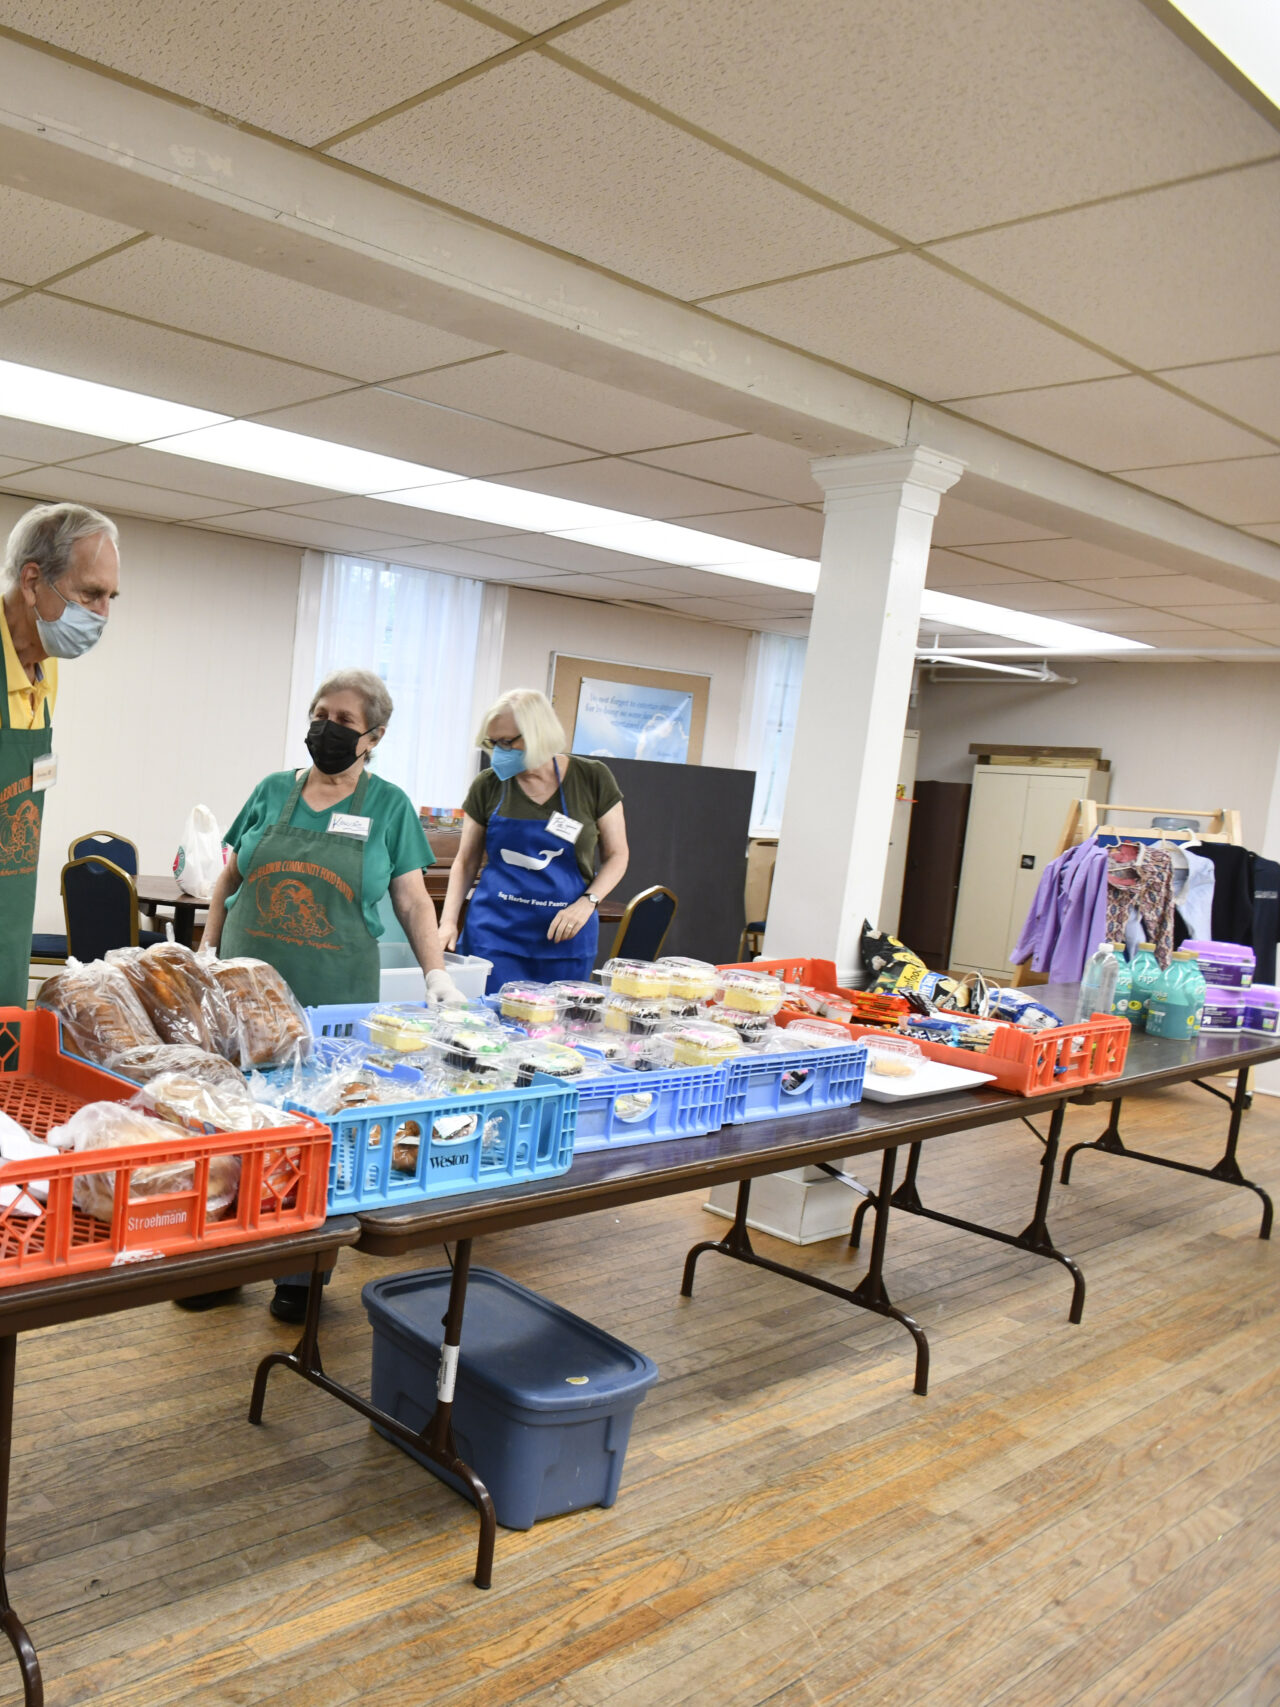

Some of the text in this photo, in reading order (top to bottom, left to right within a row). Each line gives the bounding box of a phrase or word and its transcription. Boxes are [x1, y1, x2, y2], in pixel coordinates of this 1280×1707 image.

[281, 860, 321, 876] COMMUNITY
[508, 894, 531, 905] Harbor
[430, 1154, 469, 1169] Weston
[128, 1210, 187, 1231] Stroehmann
